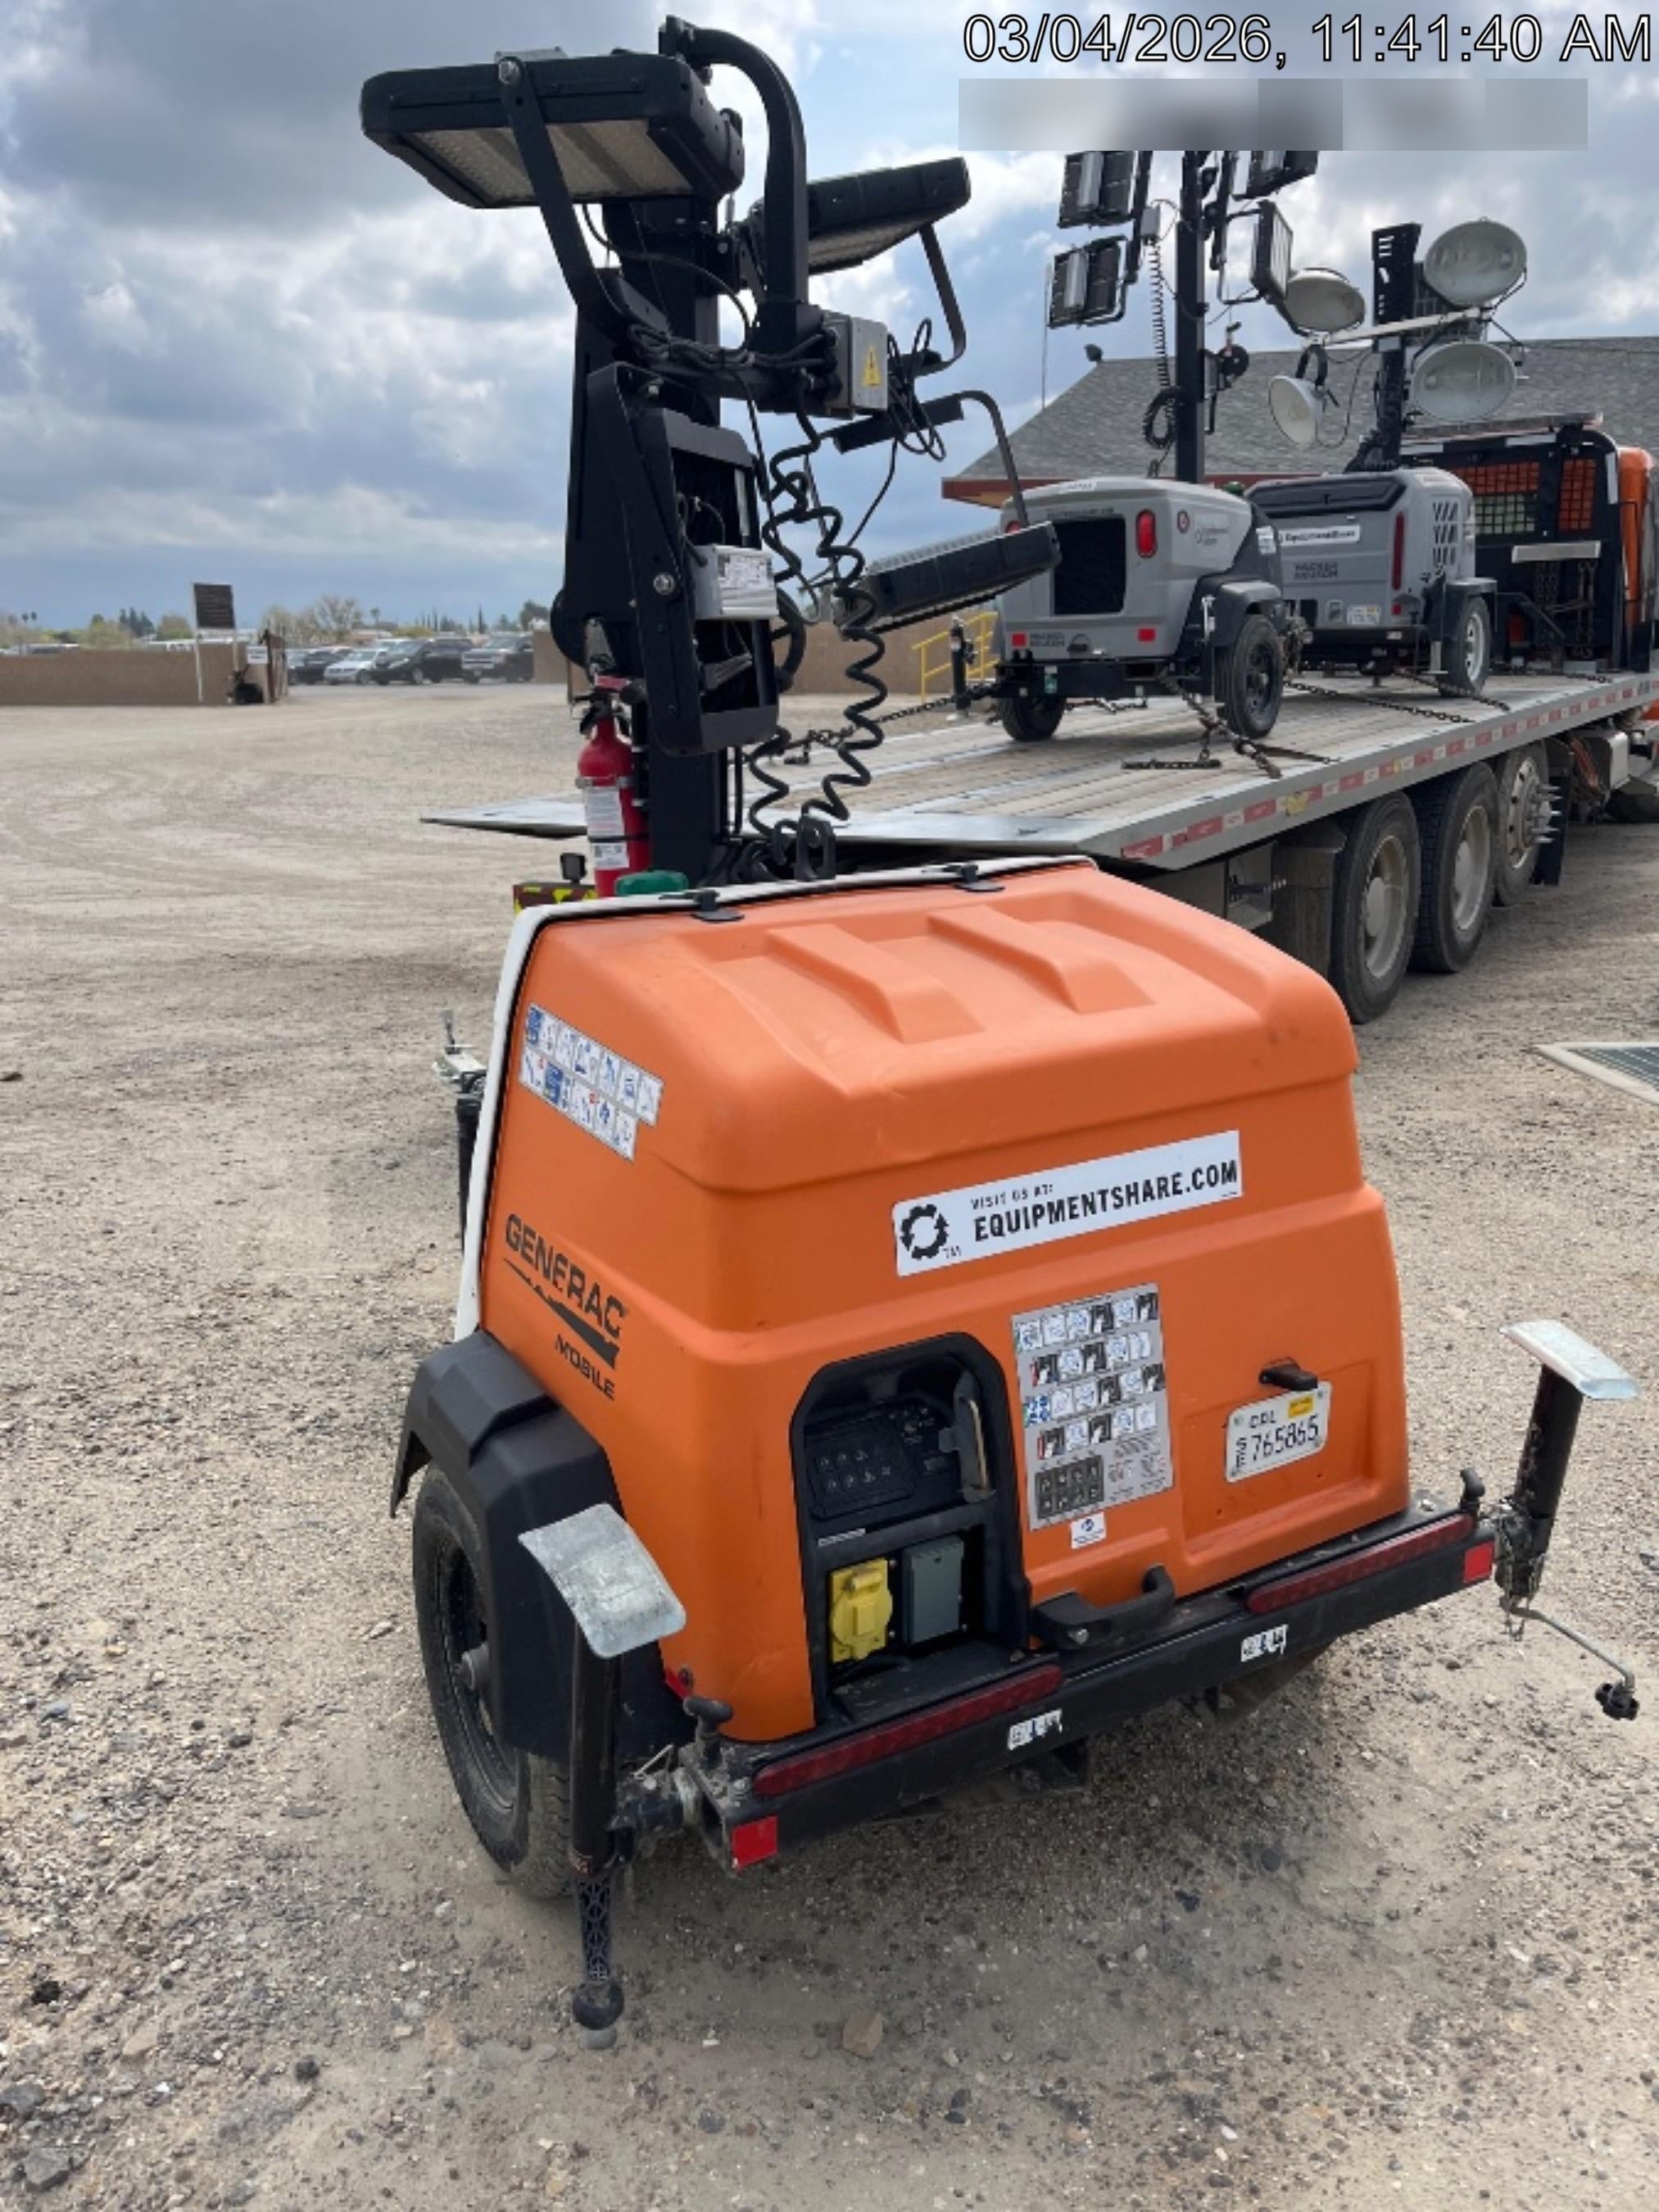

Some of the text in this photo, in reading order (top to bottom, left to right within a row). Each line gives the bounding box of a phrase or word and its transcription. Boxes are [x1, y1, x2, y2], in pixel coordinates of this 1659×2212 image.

[970, 1183, 1054, 1210] VISIT US AT:
[973, 1159, 1238, 1242] EQUIPMENTSHARE.COM
[505, 1213, 625, 1339] GENERAC
[554, 1334, 615, 1402] MOBILE
[1251, 1412, 1318, 1462] 765865
